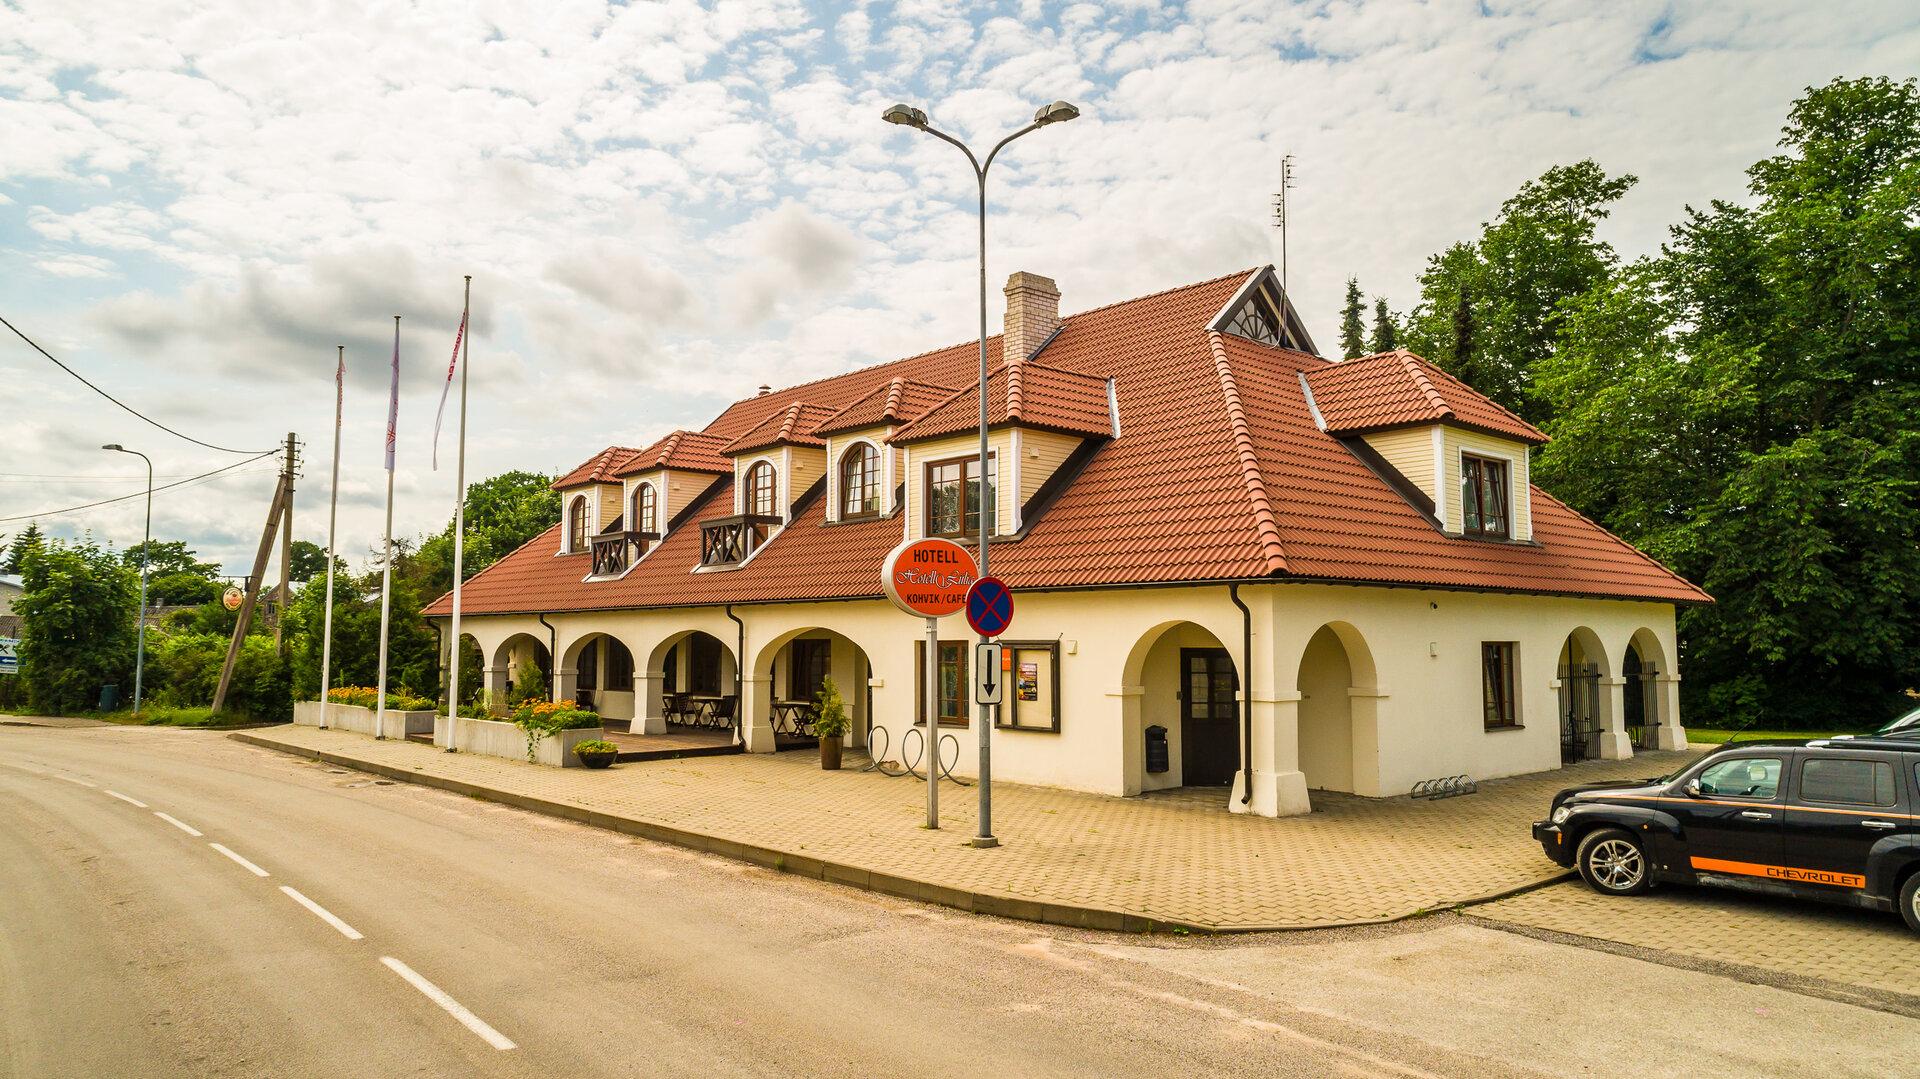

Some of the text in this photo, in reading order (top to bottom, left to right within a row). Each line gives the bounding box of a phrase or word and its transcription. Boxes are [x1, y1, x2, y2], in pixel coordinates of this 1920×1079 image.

[913, 549, 959, 564] HOTELL
[896, 567, 937, 584] Hotell
[1766, 867, 1861, 886] CHEVROLET
